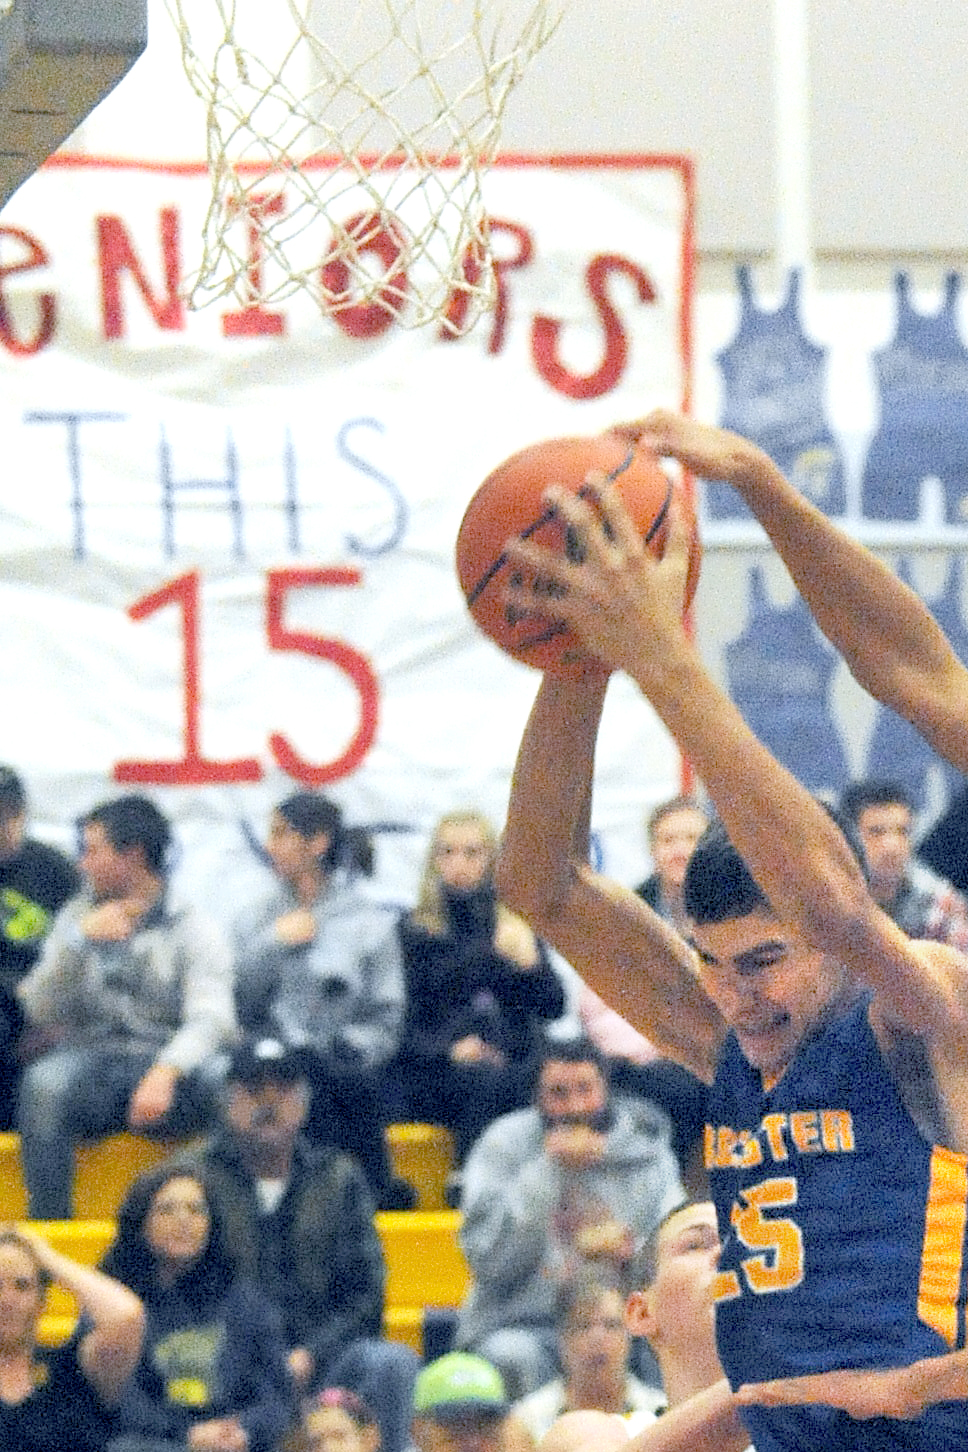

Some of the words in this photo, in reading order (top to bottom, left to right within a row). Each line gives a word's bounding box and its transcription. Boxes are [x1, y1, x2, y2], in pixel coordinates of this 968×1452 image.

[23, 410, 408, 563] THIS
[113, 566, 380, 786] 15
[712, 1177, 804, 1303] 5
